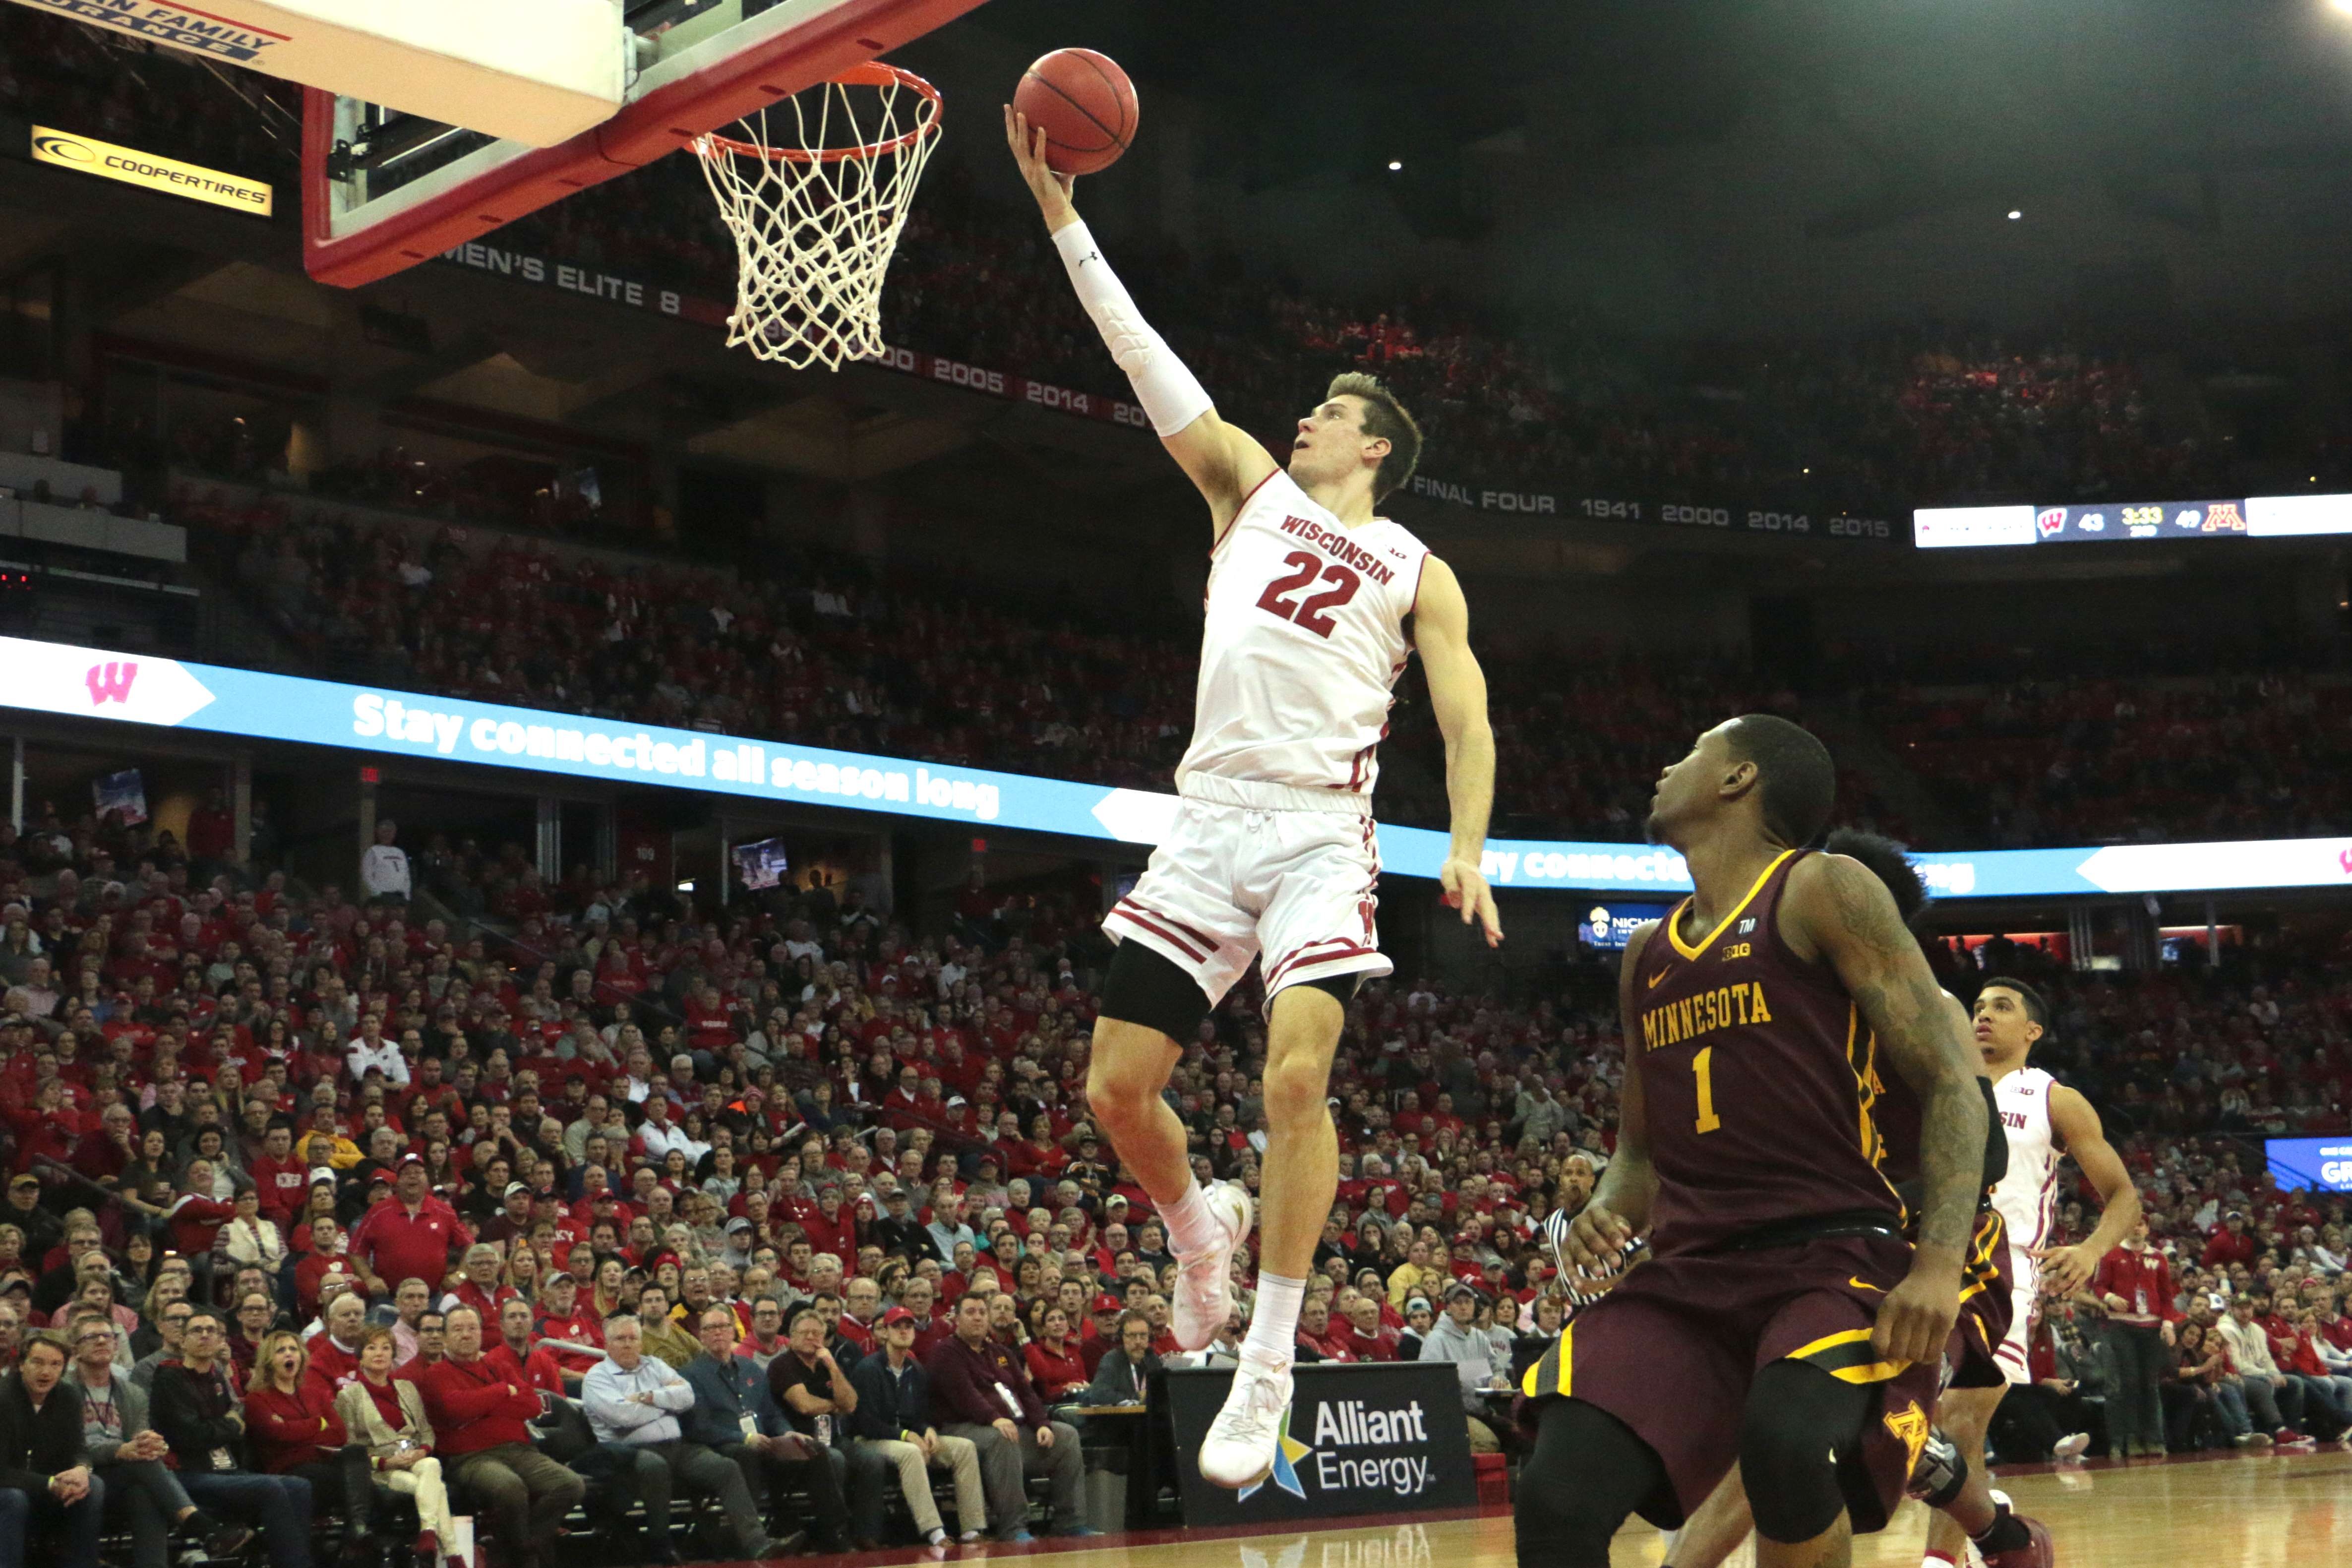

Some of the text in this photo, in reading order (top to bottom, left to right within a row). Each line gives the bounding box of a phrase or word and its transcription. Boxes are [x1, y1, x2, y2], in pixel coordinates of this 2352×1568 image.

[146, 9, 275, 49] FAMILY
[105, 155, 266, 204] COOPERTIRES
[557, 264, 643, 306] ELITE
[661, 290, 680, 315] 8
[934, 358, 1004, 394] 2005
[1026, 380, 1089, 414] 2014
[1113, 402, 1146, 427] 20
[1414, 475, 1889, 538] FINAL FOUR 1941 2000 2014 2015
[2079, 514, 2105, 531] 43
[2121, 506, 2163, 525] 3:33
[1280, 515, 1395, 586] WISCONSIN
[1256, 551, 1361, 640] 22
[354, 693, 999, 820] Stay connected all season long
[1523, 851, 1689, 882] connecte
[1739, 918, 1755, 934] TM
[1642, 981, 1772, 1052] MINNESOTA
[1692, 1046, 1721, 1134] 1
[1314, 1400, 1427, 1446] Alliant
[1317, 1452, 1428, 1495] Energy
